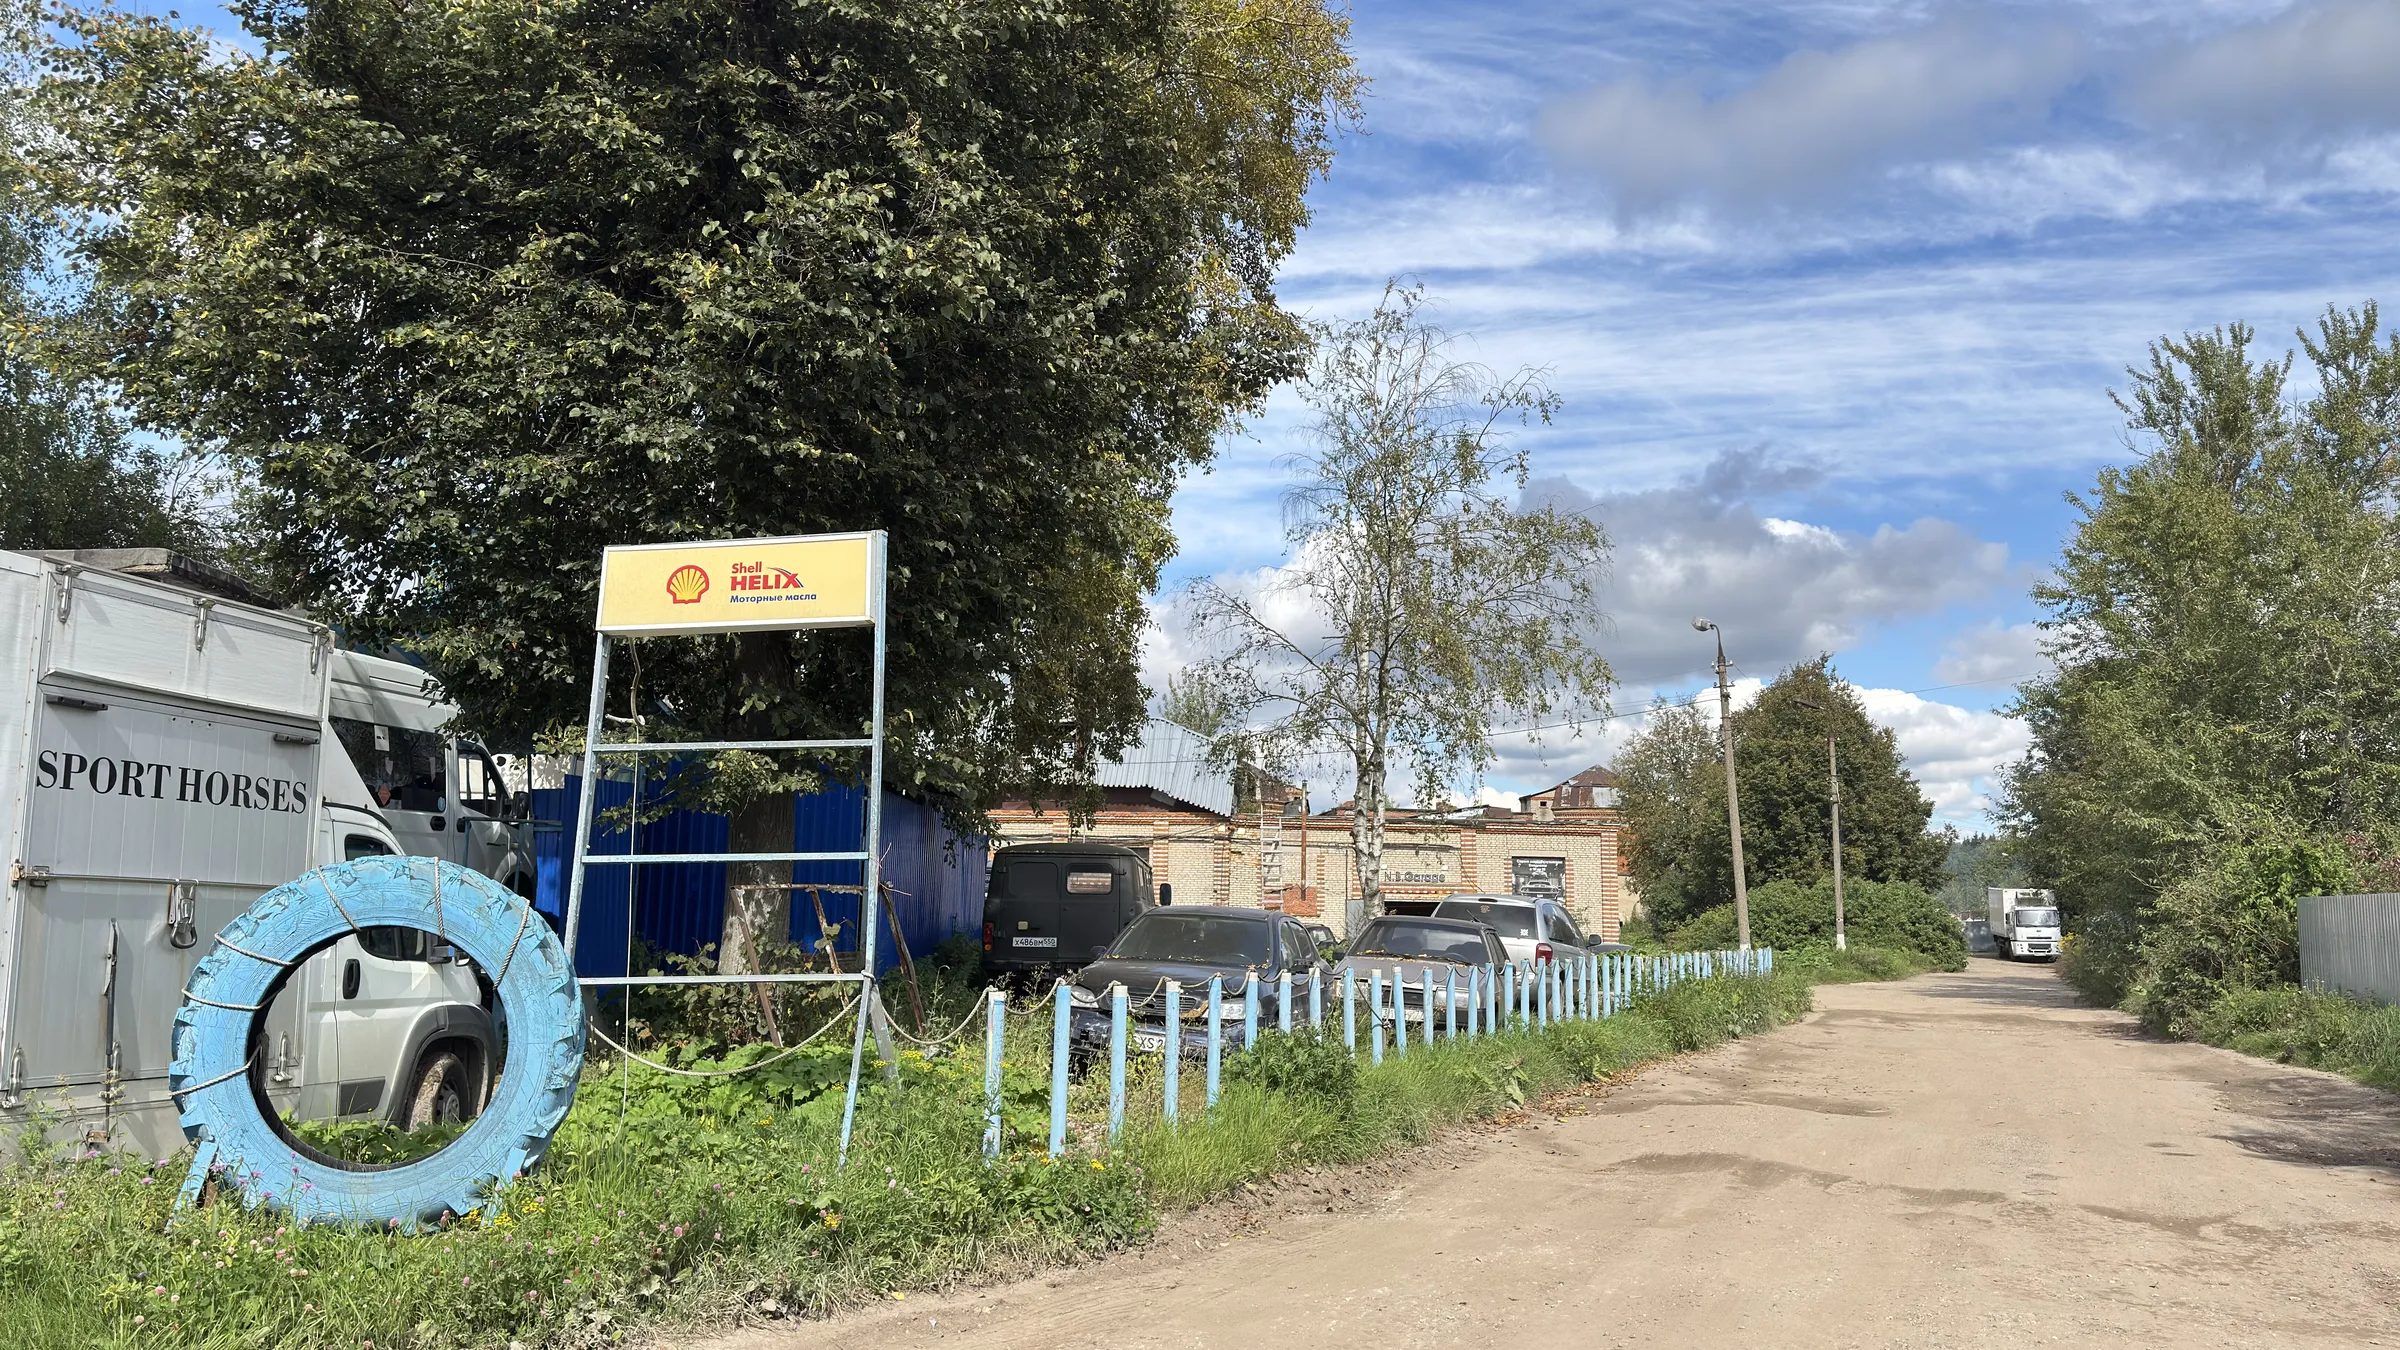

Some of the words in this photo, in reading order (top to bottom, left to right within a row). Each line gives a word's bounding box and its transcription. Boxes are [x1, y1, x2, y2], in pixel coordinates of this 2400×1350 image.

[731, 561, 762, 574] Shell
[730, 569, 802, 591] HELIX
[730, 595, 783, 604] Моторные
[785, 593, 817, 601] масла
[36, 750, 171, 799] SPORT
[176, 766, 307, 814] HORSES
